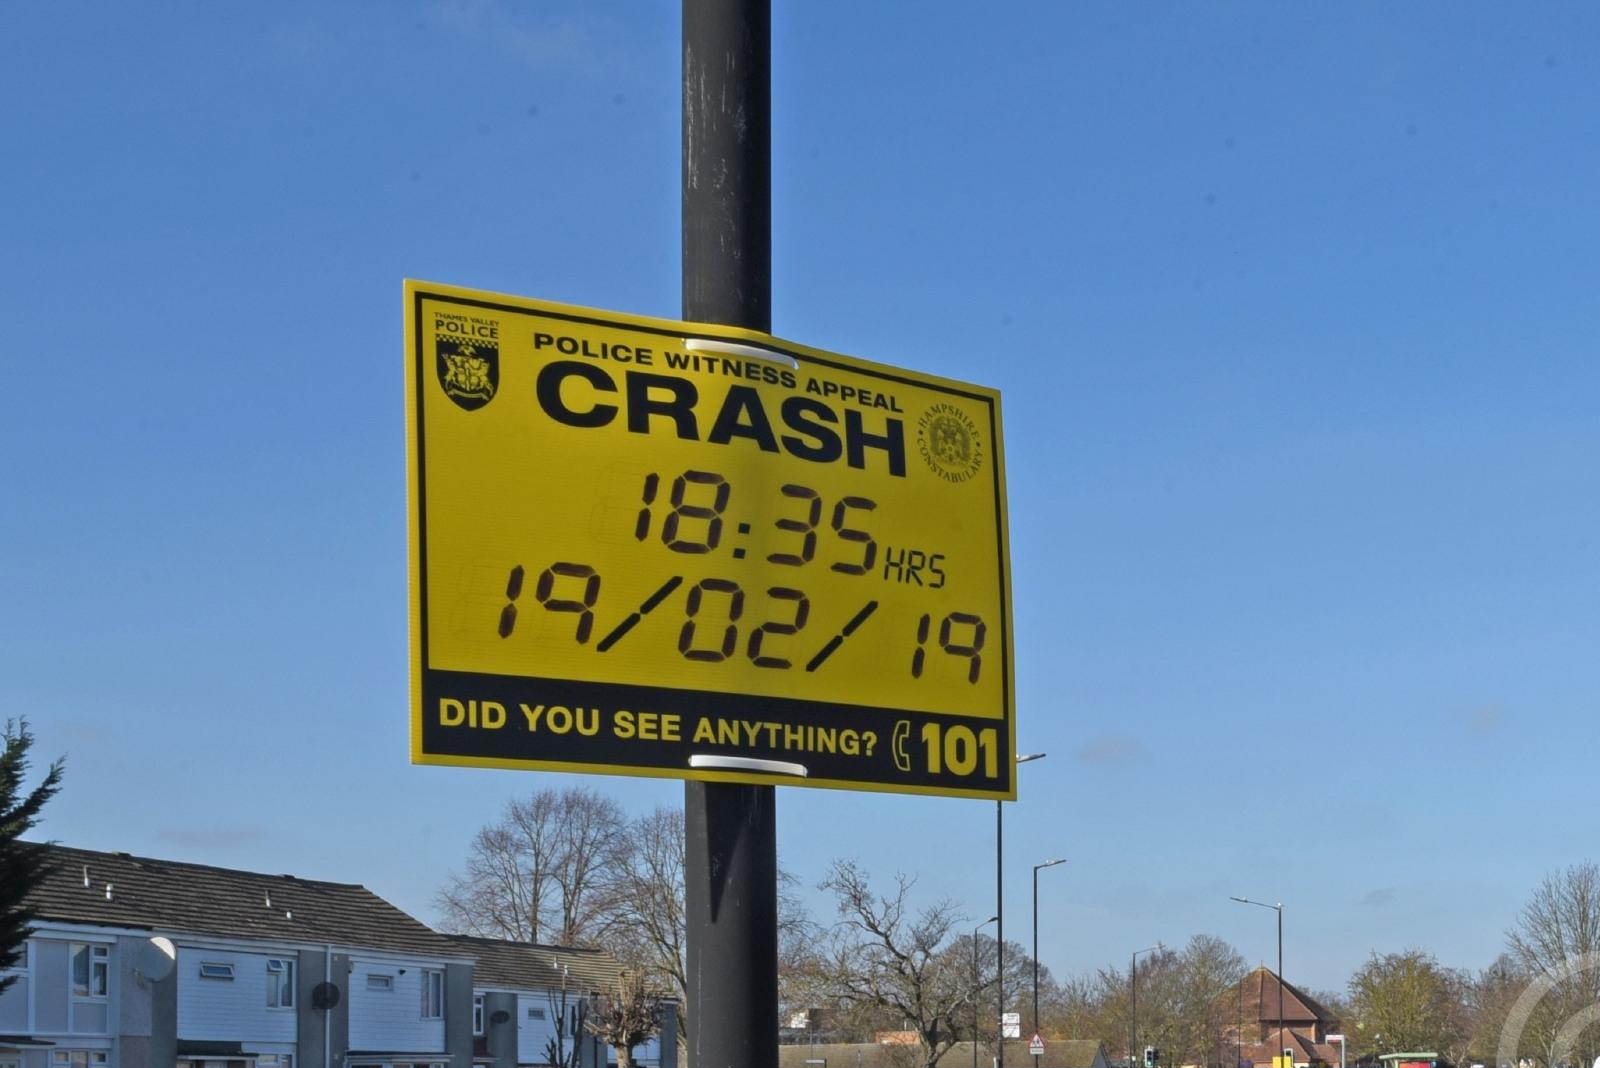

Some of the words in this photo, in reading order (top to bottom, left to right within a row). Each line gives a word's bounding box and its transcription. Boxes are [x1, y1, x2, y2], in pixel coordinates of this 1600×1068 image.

[434, 312, 468, 322] THAMES
[470, 317, 499, 326] VALLEY
[435, 320, 499, 339] POLICE
[534, 333, 653, 366] POLICE
[666, 352, 796, 389] WITNESS
[806, 377, 904, 414] APPEAL
[536, 361, 907, 478] CRASH
[635, 469, 877, 576] 18:35
[884, 546, 946, 589] HRS
[499, 562, 986, 685] 19/02/19
[439, 698, 506, 729] DID
[520, 704, 600, 736] YOU
[613, 711, 681, 742] SEE
[694, 717, 878, 756] ANYTHING?
[921, 722, 998, 778] 101
